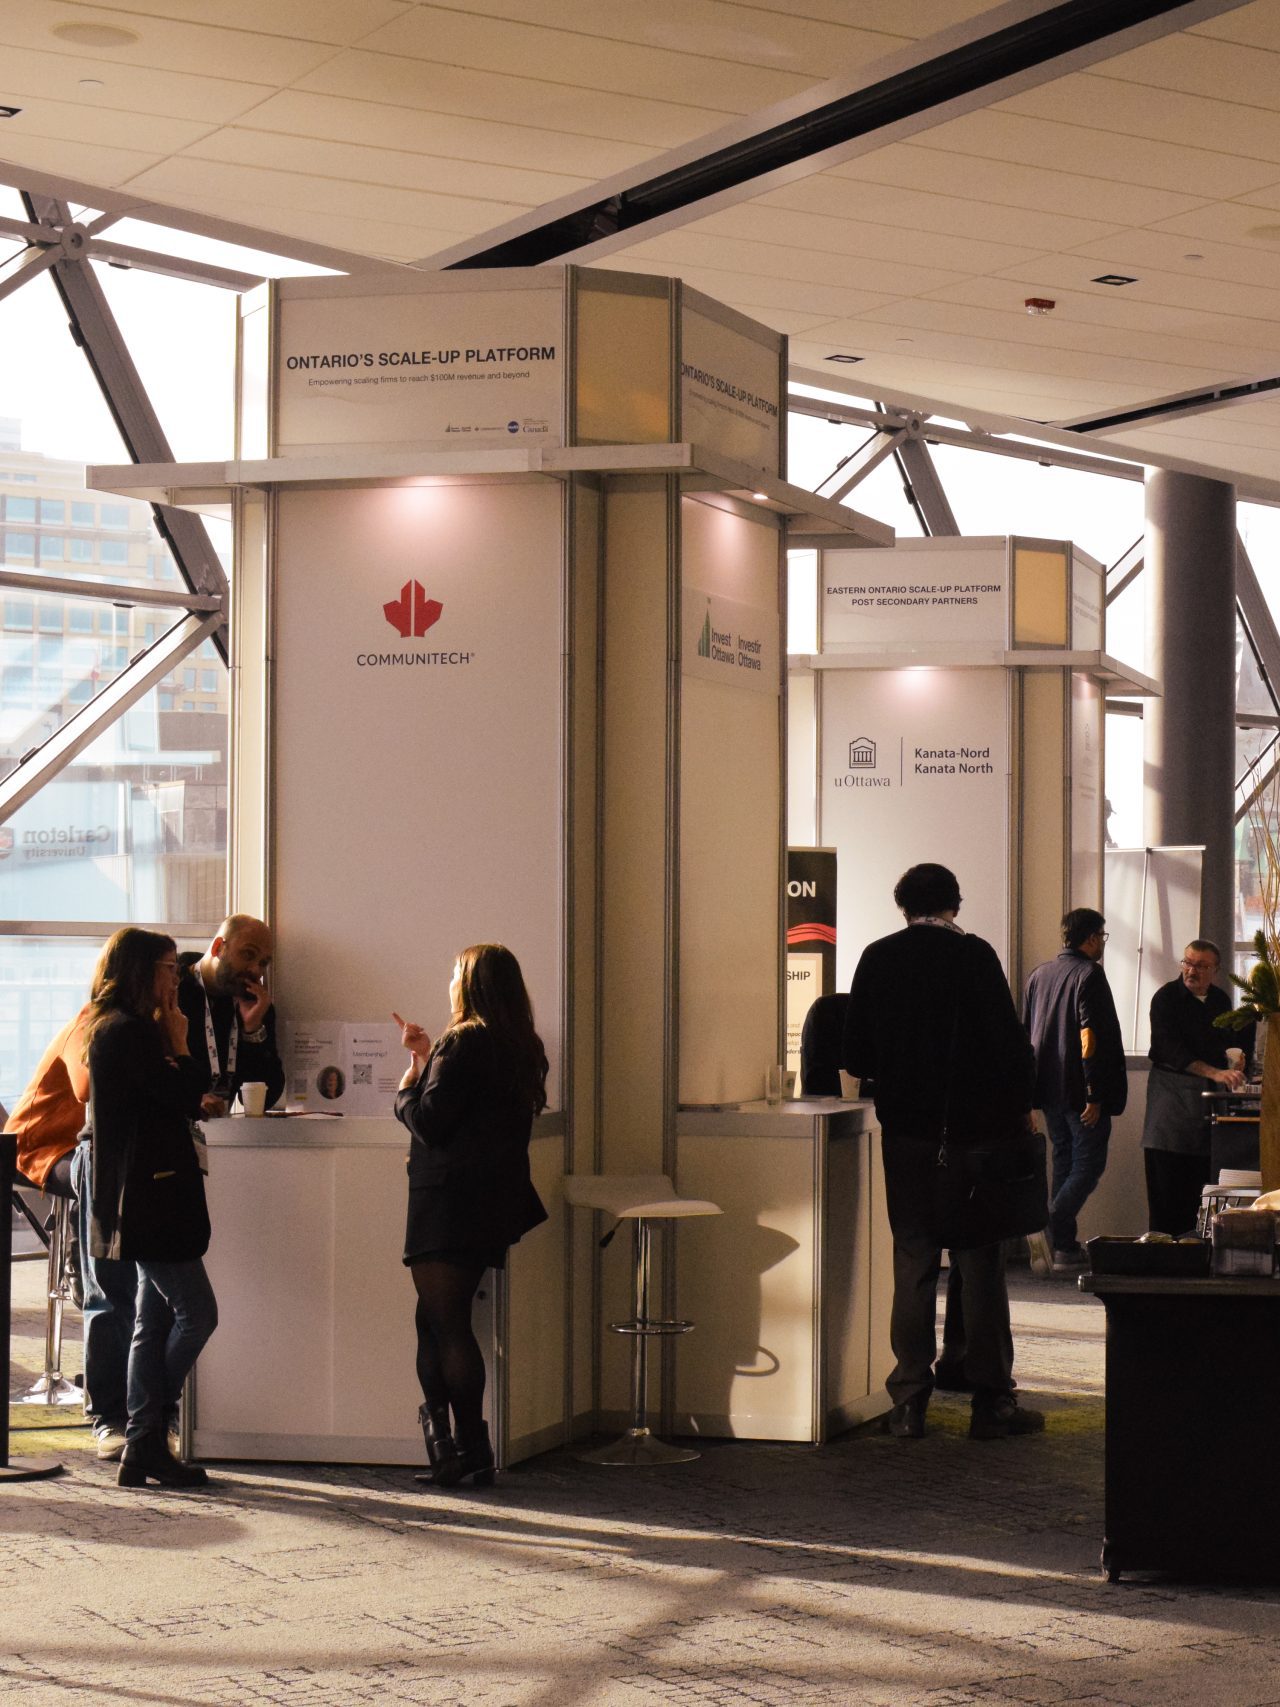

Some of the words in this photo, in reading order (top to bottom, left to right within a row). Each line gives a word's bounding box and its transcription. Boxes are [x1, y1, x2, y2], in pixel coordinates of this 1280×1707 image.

[287, 354, 374, 370] ONTARIO'S
[378, 350, 460, 366] SCALE-UP
[465, 347, 555, 363] PLATFORM
[308, 378, 352, 388] Empowering
[354, 376, 379, 385] scaling
[380, 375, 398, 384] firms
[409, 374, 429, 382] reach
[430, 373, 455, 382] $100M
[487, 371, 501, 380] and
[502, 371, 530, 381] beyond
[681, 362, 715, 389] ONTARIO'S
[715, 378, 747, 402] SCALE-UP
[747, 393, 778, 417] PLATFORM
[827, 586, 866, 595] EASTERN
[868, 586, 907, 594] ONTARIO
[908, 585, 952, 593] SCALE-UP
[954, 585, 1001, 593] PLATFORM
[851, 598, 875, 606] POST
[876, 597, 930, 605] SECONDARY
[932, 597, 978, 605] PARTNERS
[711, 627, 732, 648] Invest
[738, 634, 761, 654] Investir
[711, 645, 735, 665] Ottawa
[738, 652, 761, 671] Ottawa
[914, 748, 990, 759] Kanata-Nord
[914, 763, 955, 774] Kanata
[959, 763, 994, 774] North
[834, 775, 891, 787] uOttawa
